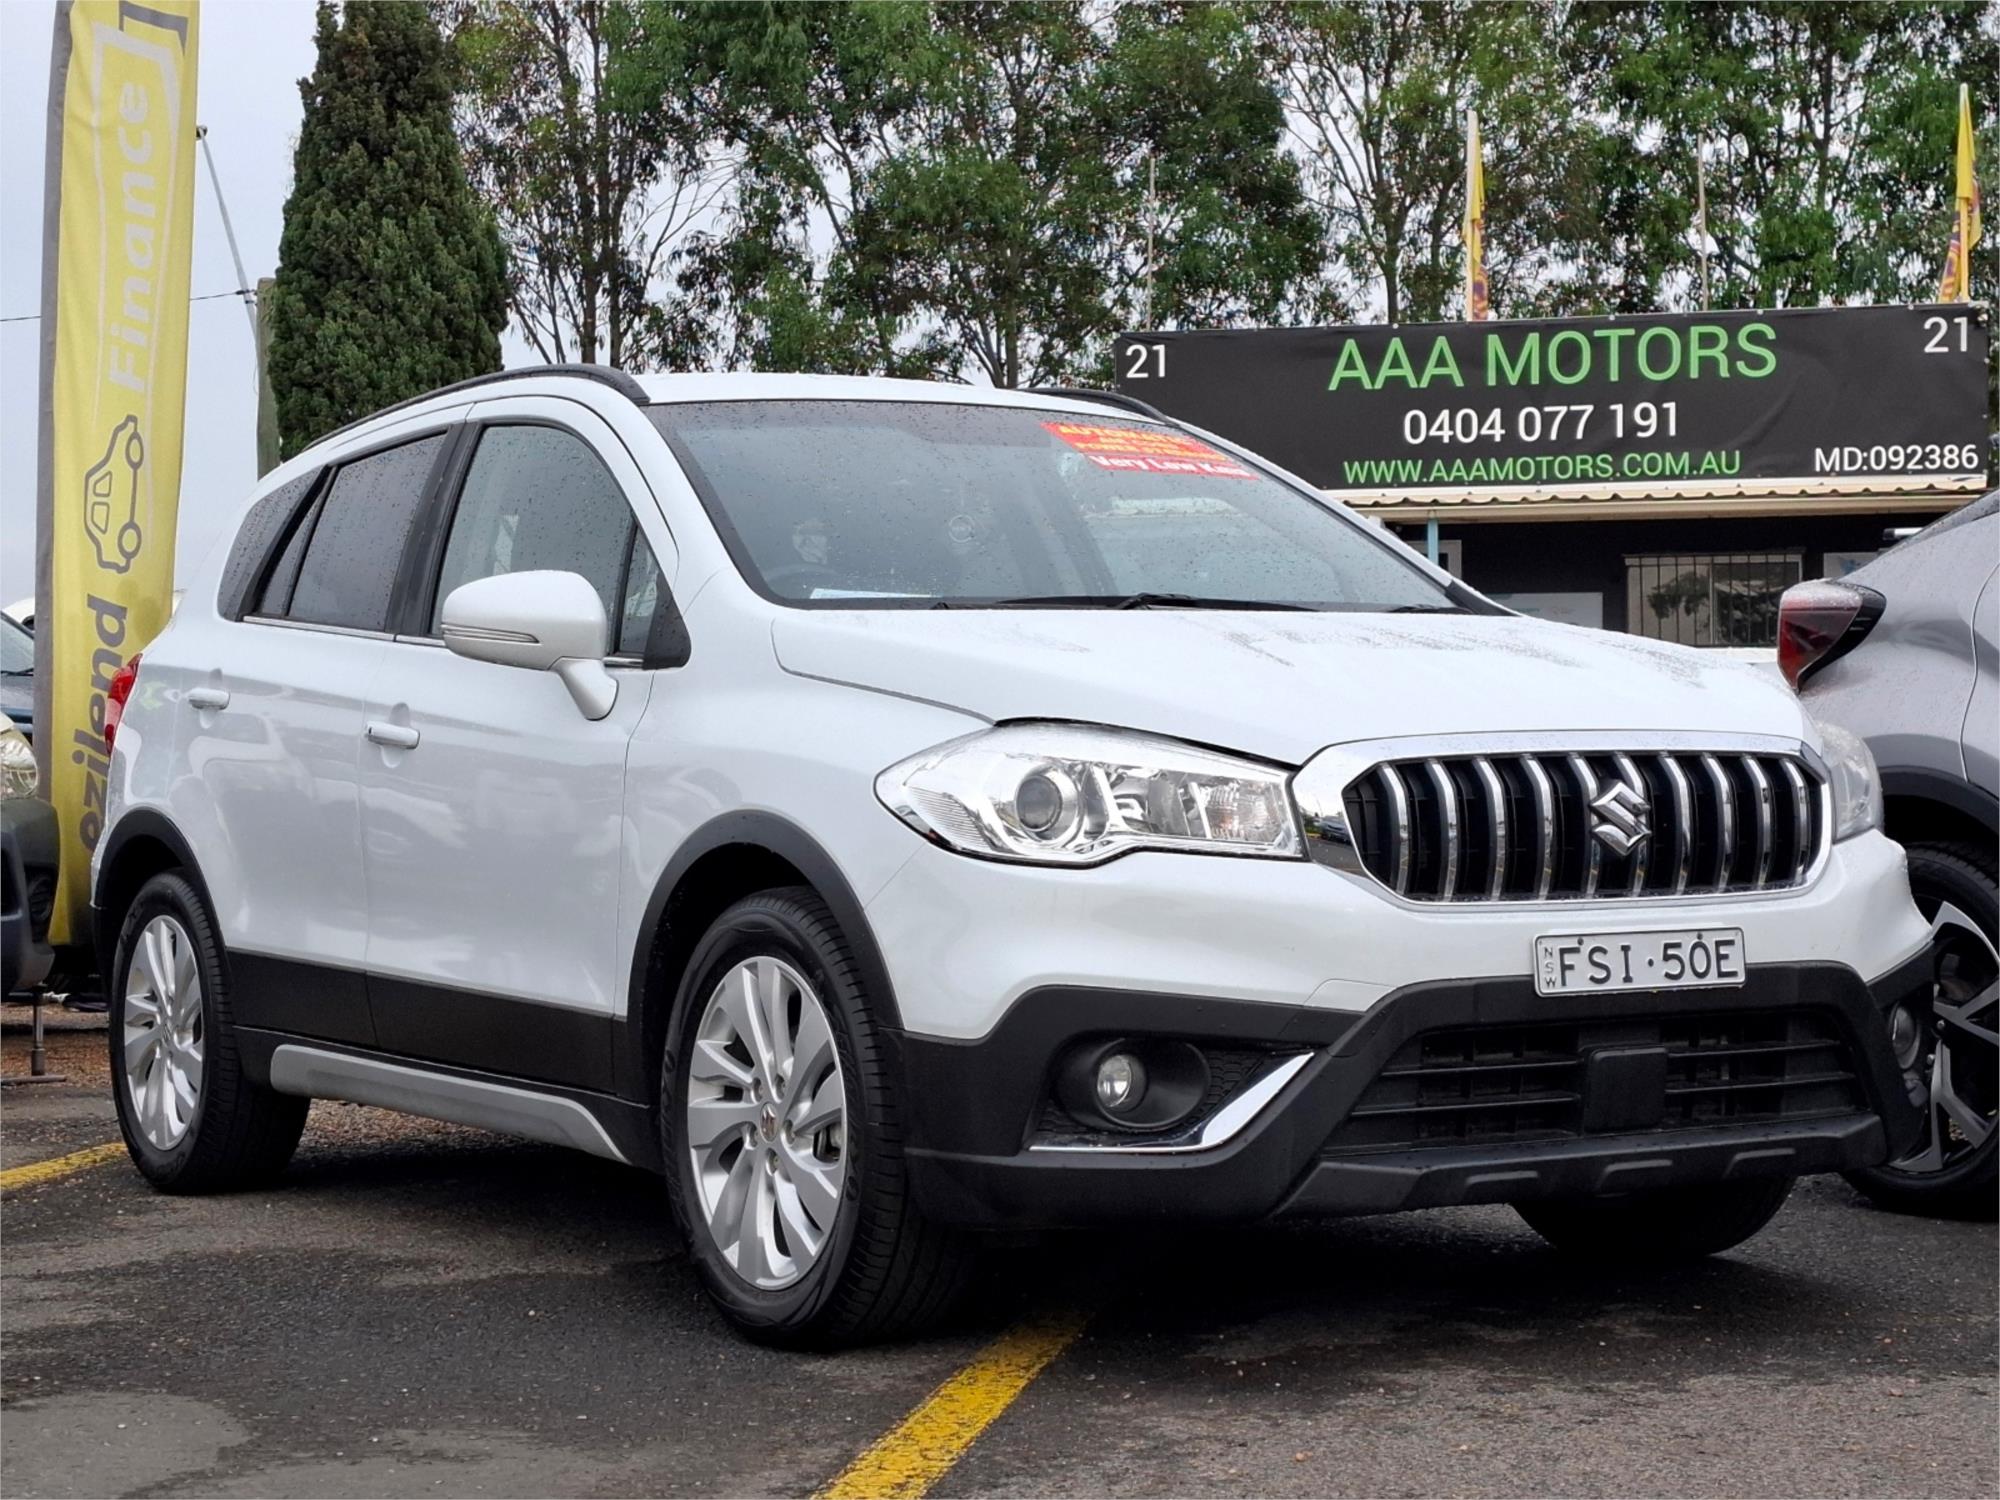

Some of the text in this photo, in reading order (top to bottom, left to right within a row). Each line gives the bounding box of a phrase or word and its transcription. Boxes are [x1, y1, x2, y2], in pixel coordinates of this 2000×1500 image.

[108, 82, 156, 393] Finance
[1924, 316, 1968, 353] 21
[1125, 344, 1166, 378] 21
[1328, 323, 1777, 391] AAA MOTORS
[1403, 402, 1677, 444] 0404 077 191
[1088, 455, 1150, 470] Very
[1343, 451, 1741, 484] WWW.AAAMOTORS.COM.AU
[1815, 444, 1979, 472] MD:092386
